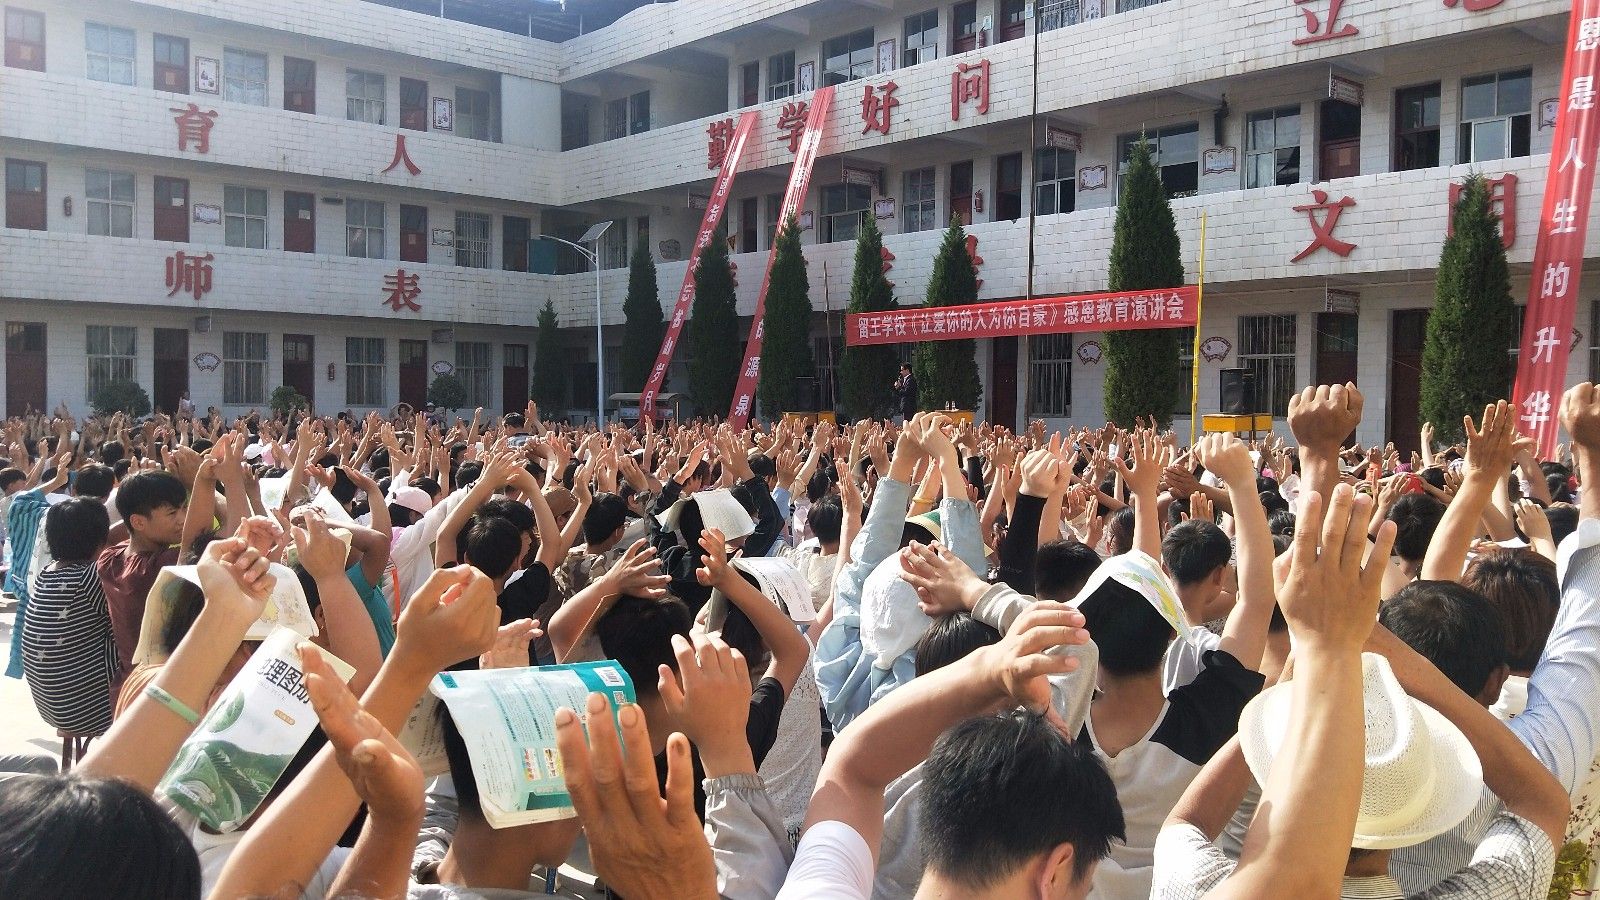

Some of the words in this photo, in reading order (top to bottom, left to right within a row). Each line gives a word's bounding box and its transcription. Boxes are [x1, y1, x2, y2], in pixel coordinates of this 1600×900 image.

[1520, 17, 1600, 430] 恩是人生的升华
[857, 292, 1185, 340] 留王学校《让爱你的人为你自豪》感恩教育演讲会
[257, 657, 310, 704] 理图册
